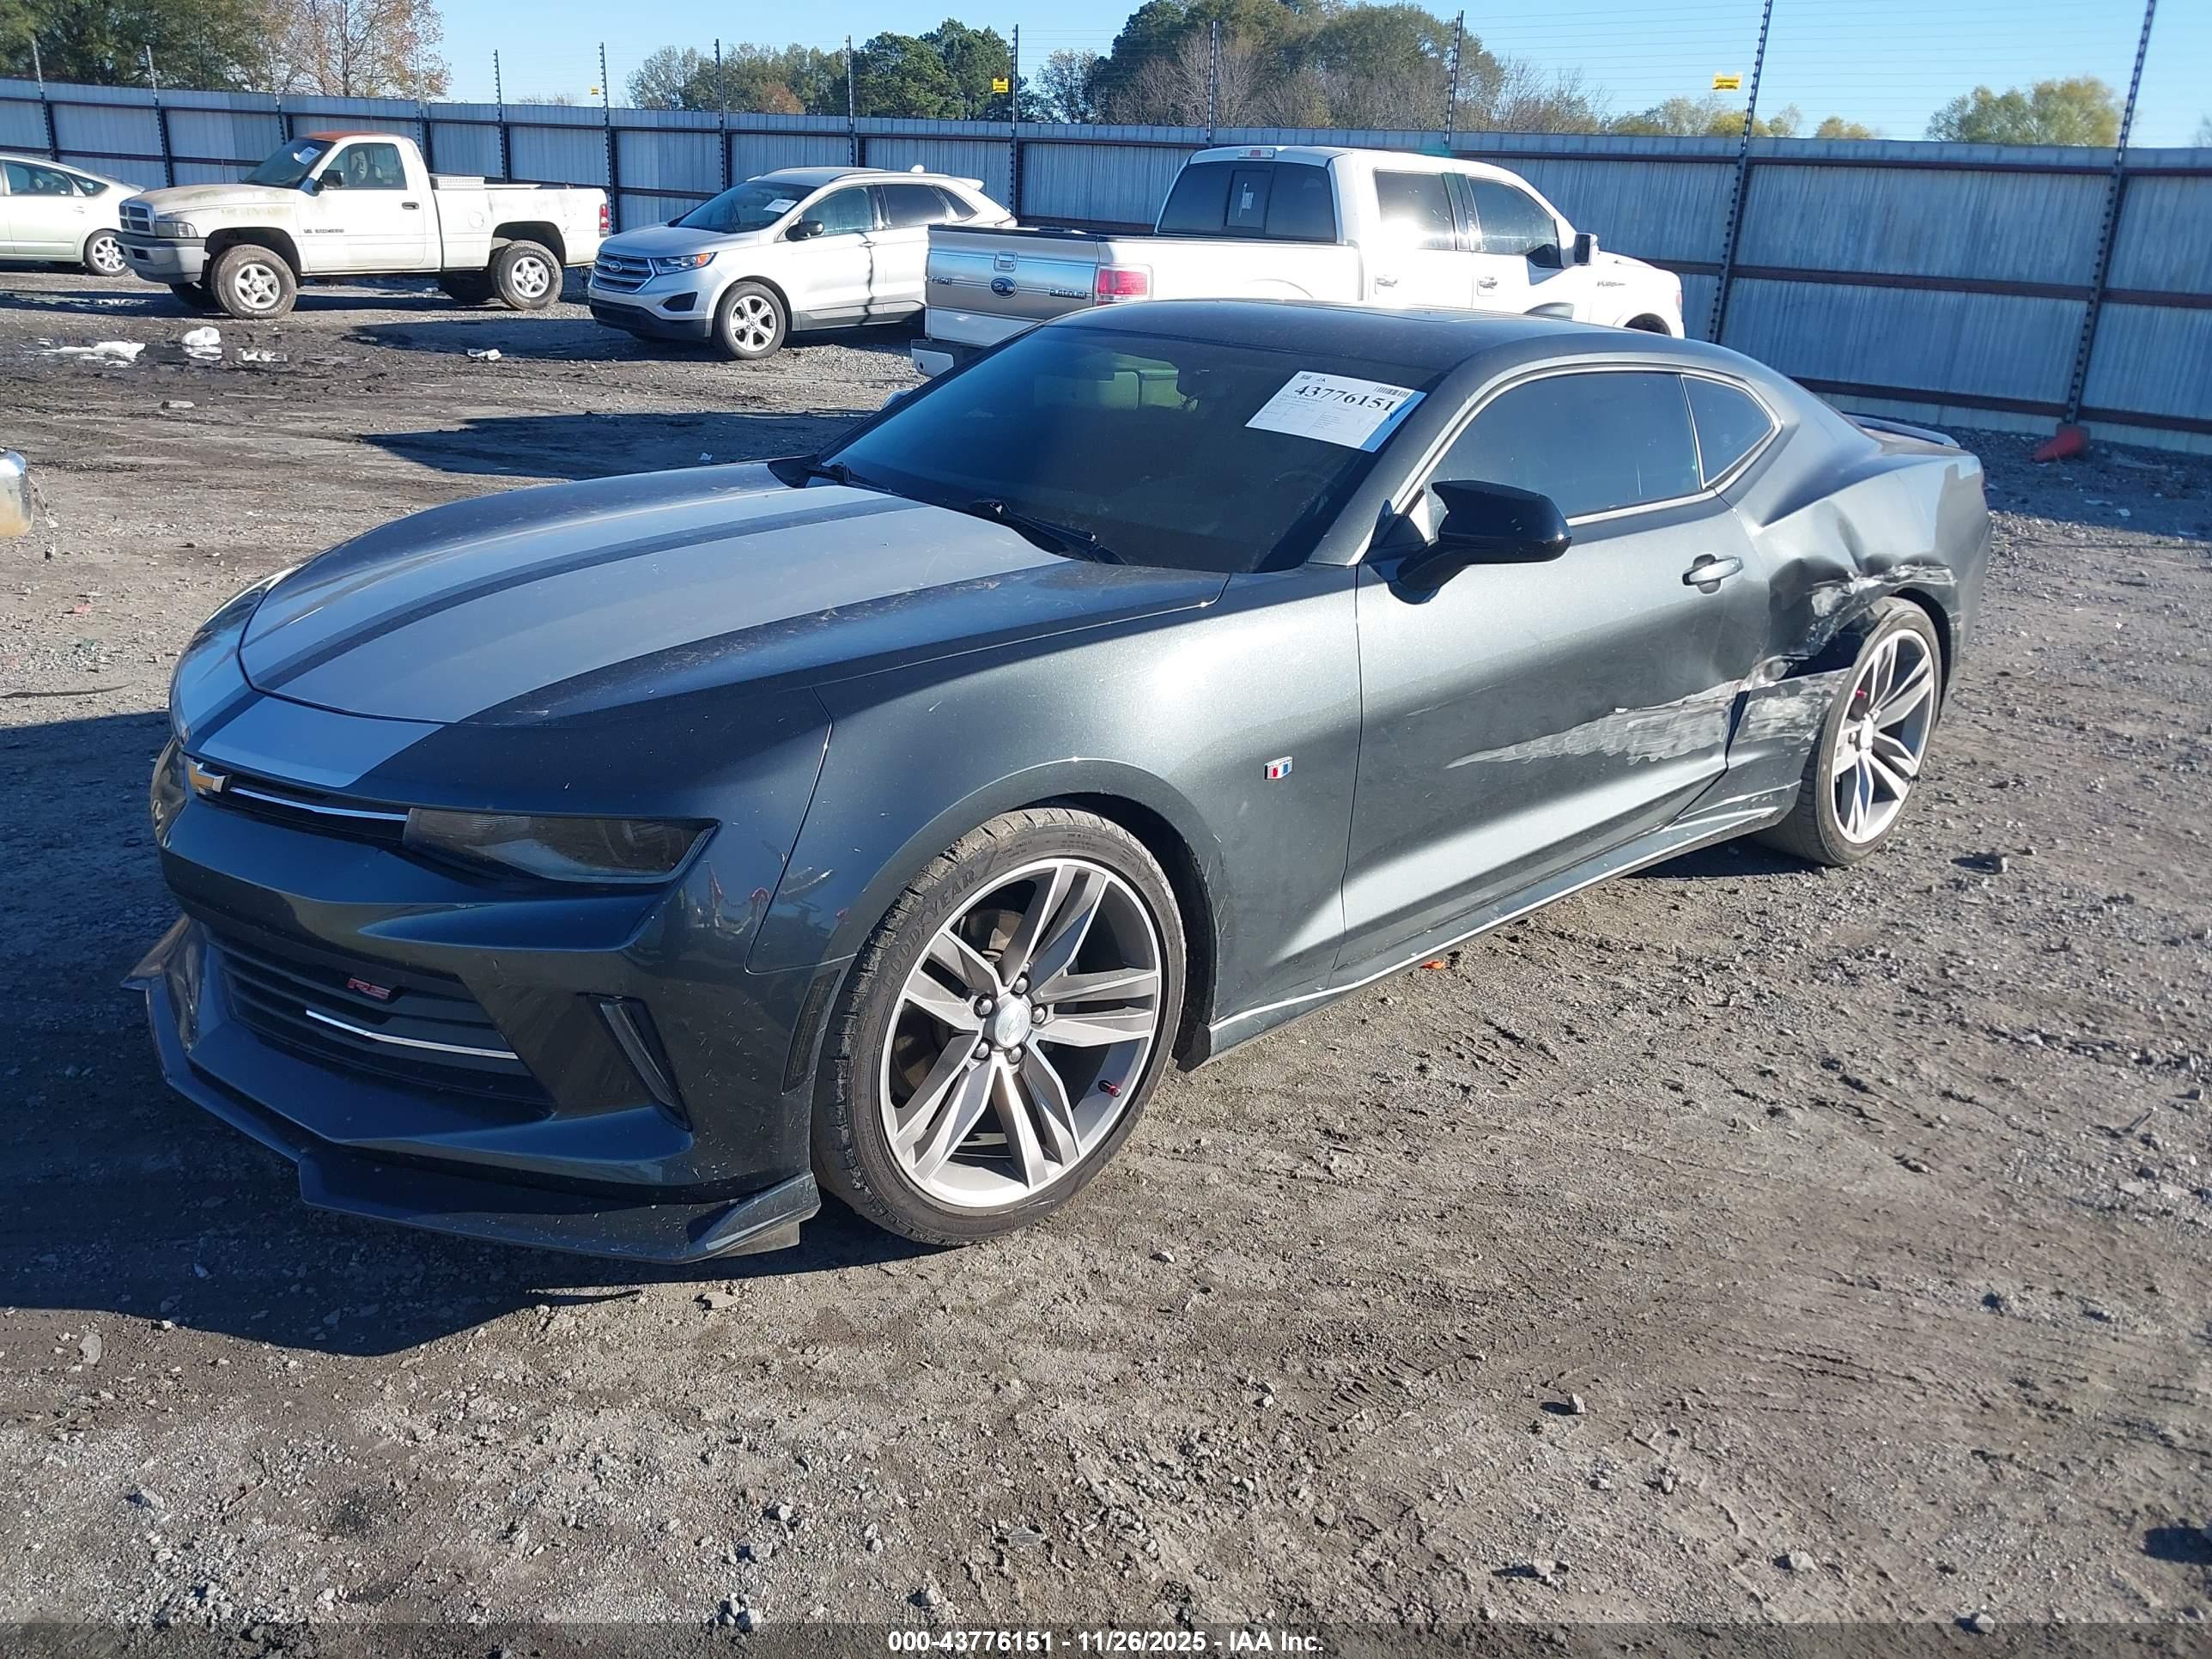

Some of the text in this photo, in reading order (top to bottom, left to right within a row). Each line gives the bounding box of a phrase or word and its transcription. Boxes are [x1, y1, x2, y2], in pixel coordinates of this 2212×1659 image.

[1294, 385, 1395, 412] 43776151
[882, 869, 976, 997] GOODYEAR
[348, 977, 392, 1000] RS
